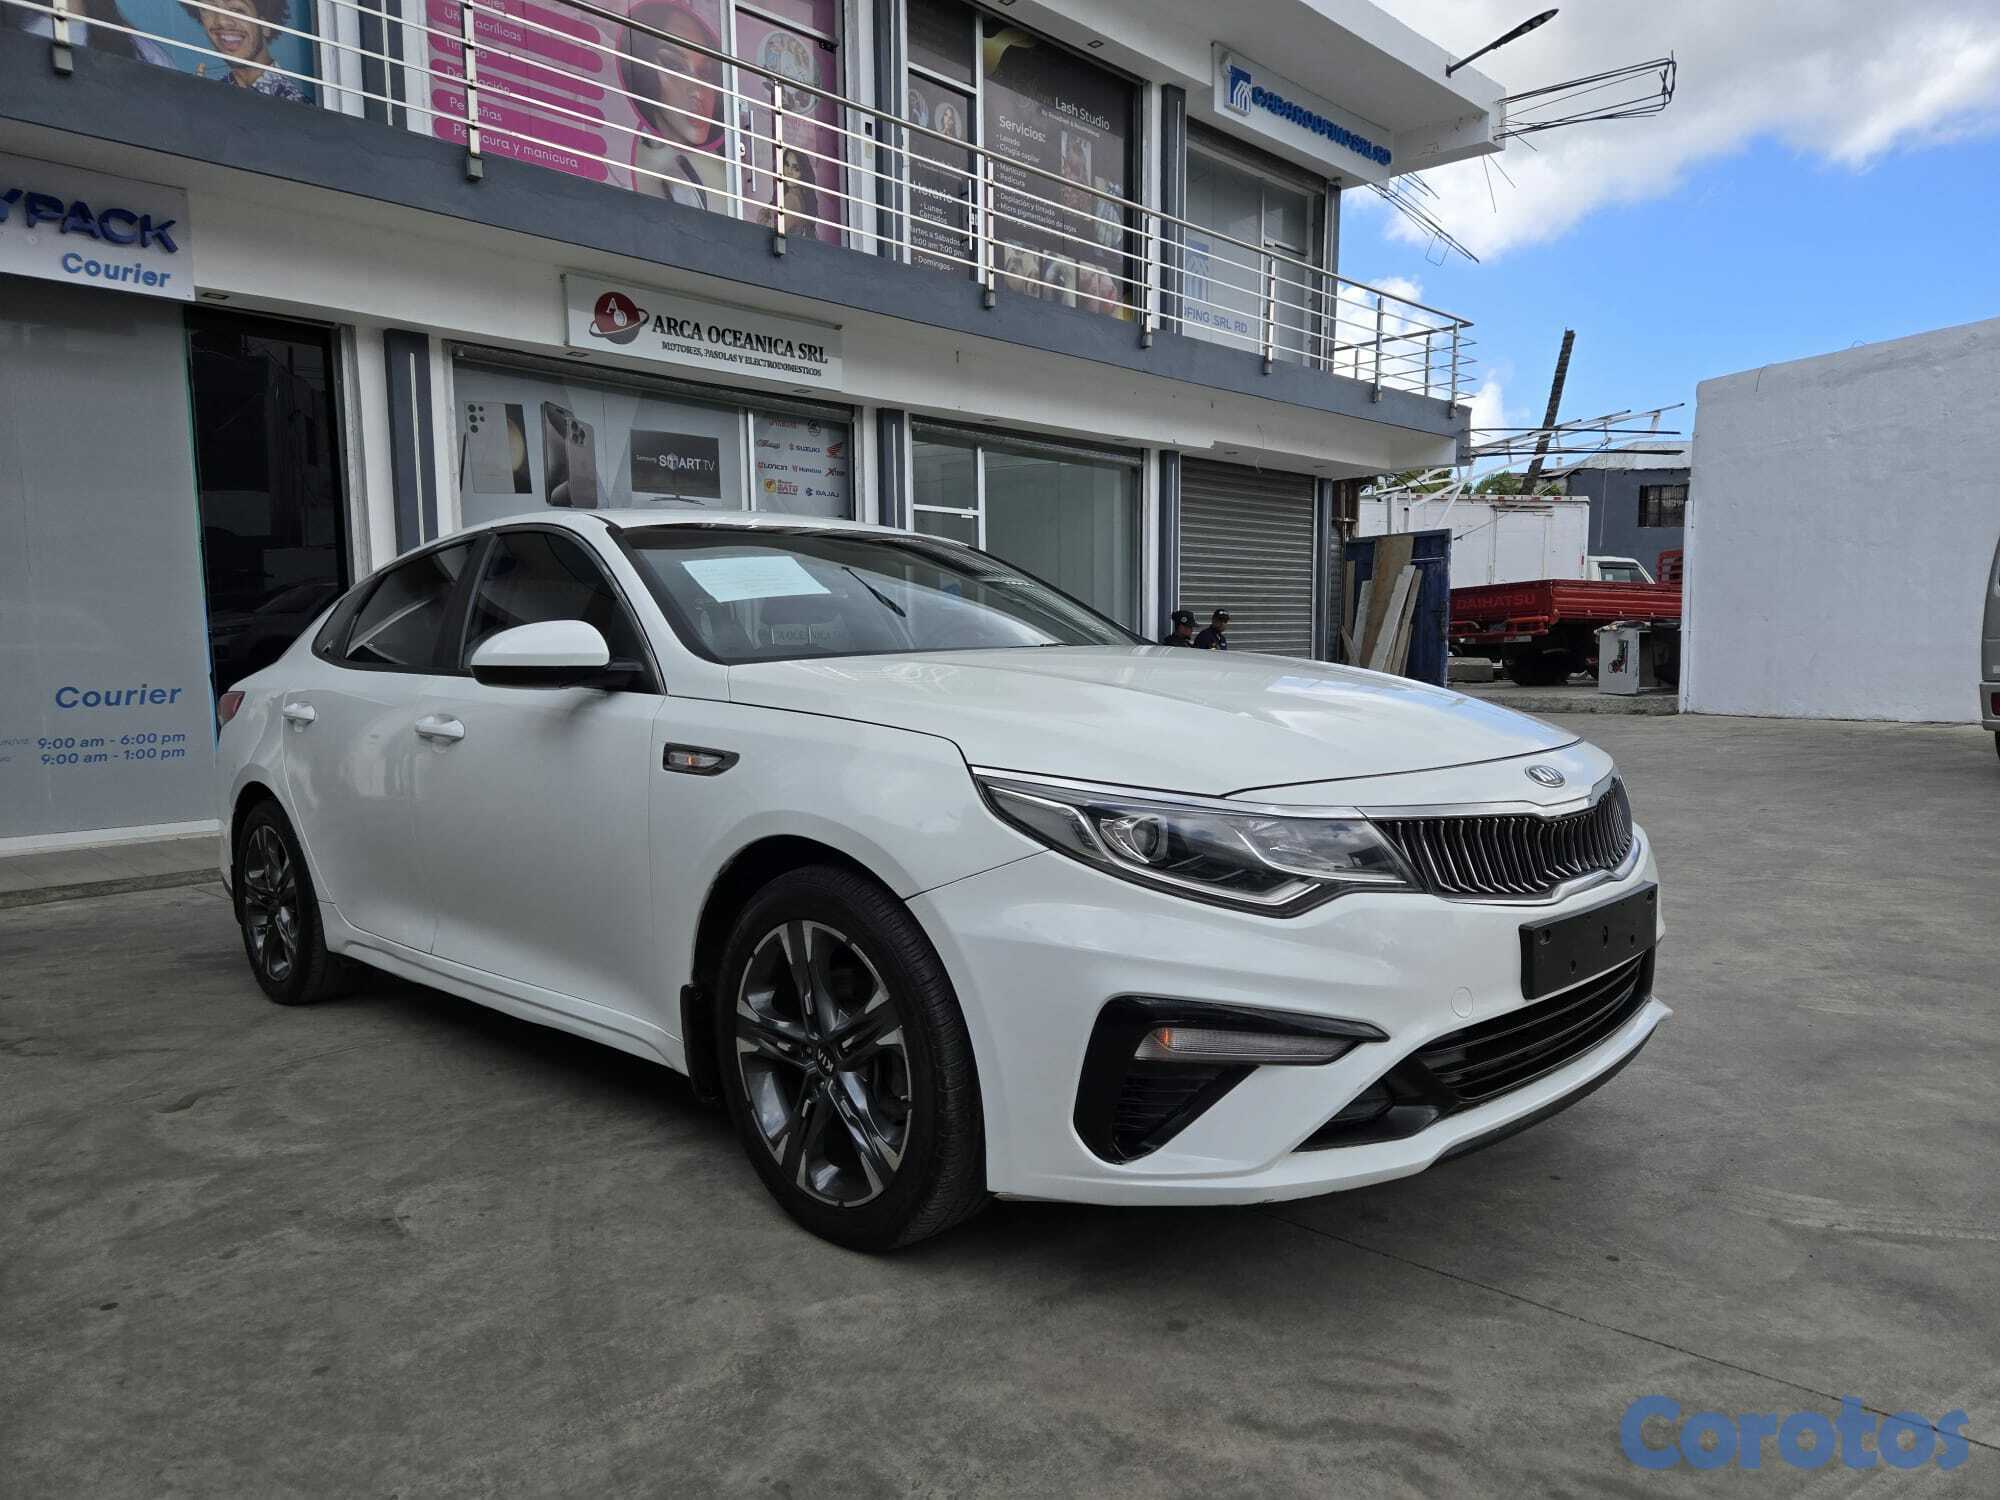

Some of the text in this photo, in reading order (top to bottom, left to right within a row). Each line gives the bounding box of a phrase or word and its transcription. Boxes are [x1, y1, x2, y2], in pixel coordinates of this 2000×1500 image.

[1055, 96, 1078, 117] Lash
[1079, 107, 1110, 130] Studio
[999, 115, 1046, 143] Servicios:
[512, 142, 520, 153] y
[523, 145, 578, 168] manicura
[62, 252, 171, 288] Courier
[652, 315, 828, 364] ARCA OCEANICA SRL
[55, 683, 182, 709] Courier
[37, 737, 76, 750] 9:00
[79, 737, 105, 748] am
[120, 733, 157, 745] 6:00
[161, 733, 185, 744] pm
[41, 753, 79, 765] 9:00
[83, 752, 108, 762] am
[123, 748, 157, 760] 1:00
[161, 747, 185, 760] pm
